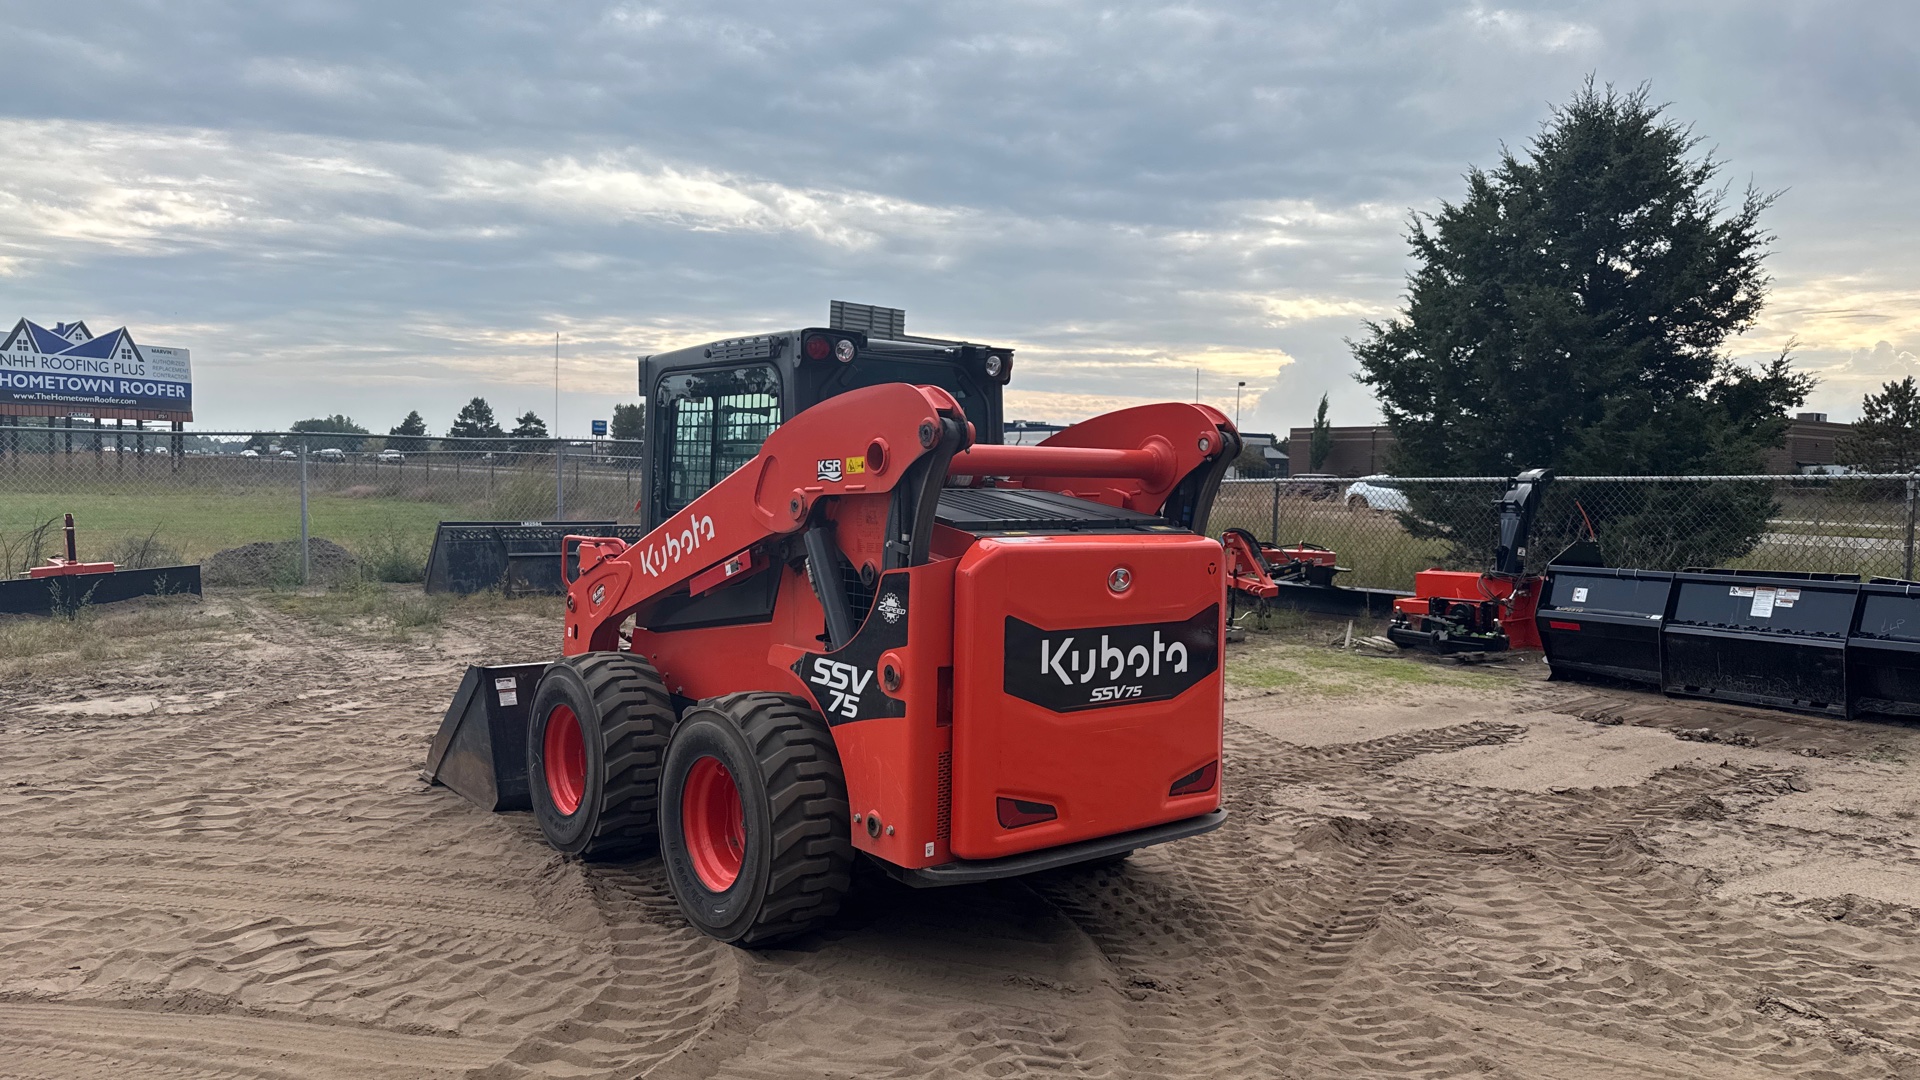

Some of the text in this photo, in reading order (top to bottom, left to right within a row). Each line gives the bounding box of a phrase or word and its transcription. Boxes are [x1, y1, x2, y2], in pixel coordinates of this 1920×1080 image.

[0, 354, 145, 376] NHH ROOFING PLUS
[152, 359, 186, 367] AUTHORIZED
[152, 365, 189, 374] REPLACEMENT
[0, 373, 186, 398] HOMETOWN ROOFER
[152, 372, 188, 380] CONTRACTOR
[13, 392, 137, 405] www.TheHometownRoofer.com
[817, 459, 842, 472] KSR
[640, 514, 715, 577] Kubota
[1041, 630, 1188, 685] Kubota
[810, 657, 873, 695] SSV
[828, 690, 860, 718] 75
